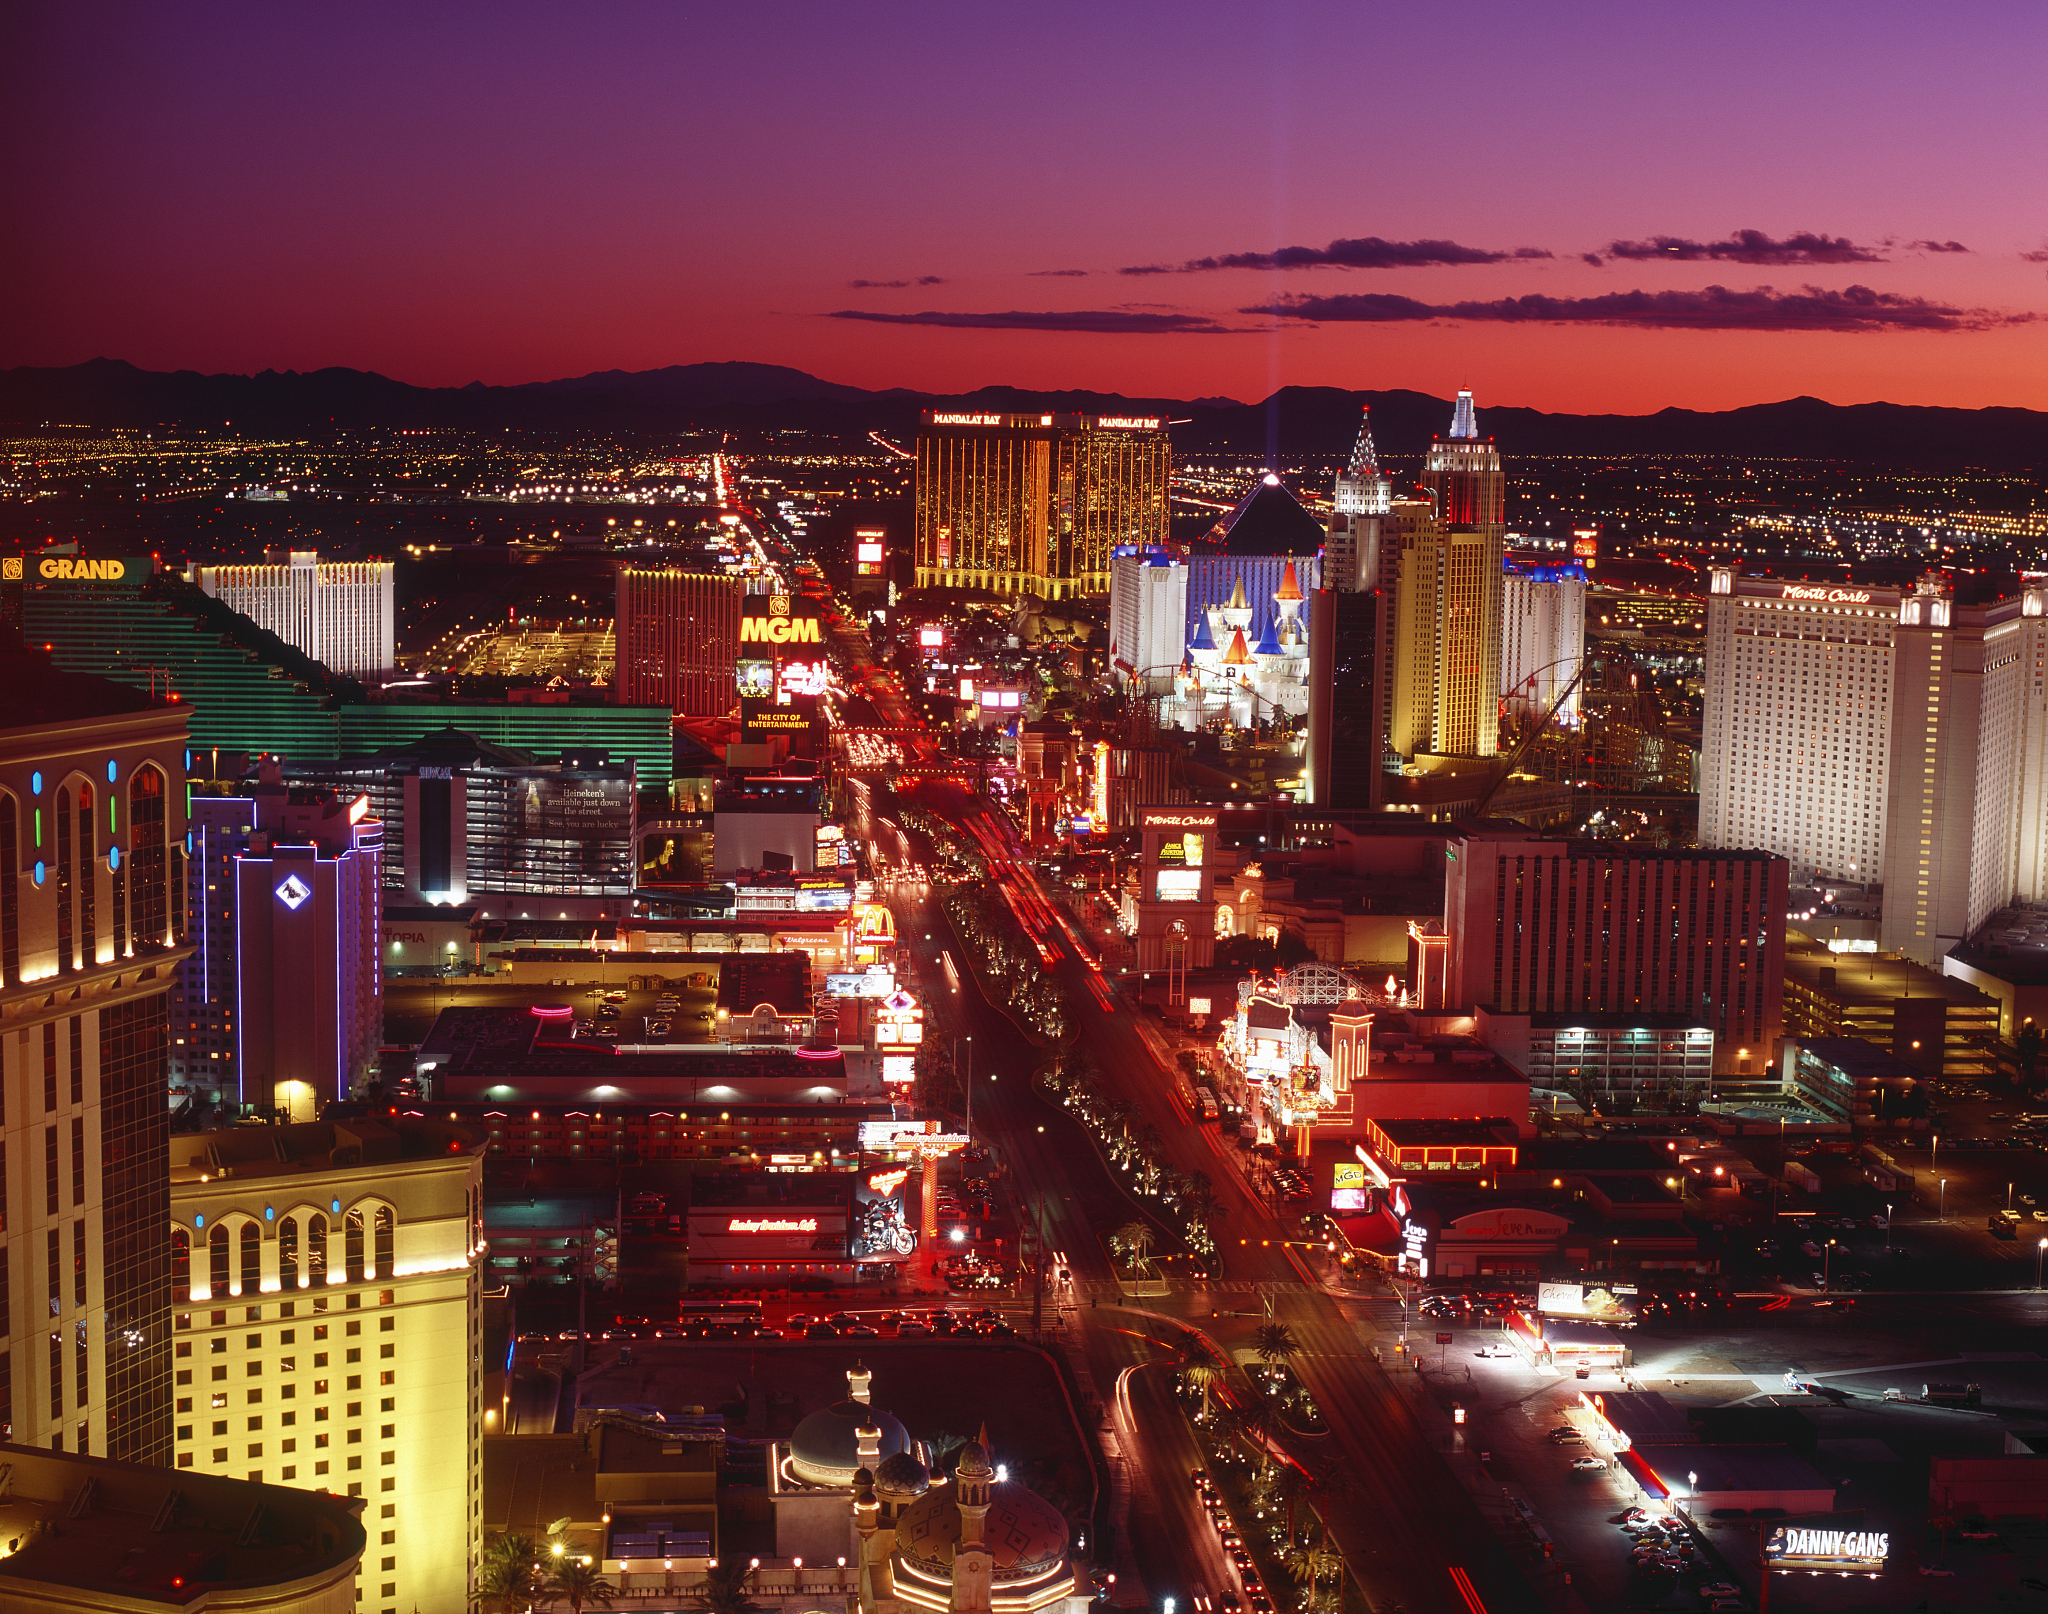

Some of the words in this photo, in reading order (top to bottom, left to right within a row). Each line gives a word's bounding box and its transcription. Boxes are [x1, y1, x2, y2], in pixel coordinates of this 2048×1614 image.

[934, 415, 982, 424] MANDALAY
[984, 415, 1001, 425] BAY
[1099, 418, 1143, 428] MANDALAY
[1144, 419, 1160, 429] BAY
[39, 558, 125, 580] GRAND
[1782, 585, 1827, 600] Monte
[1828, 589, 1870, 604] Carlo
[740, 617, 820, 643] MGM
[740, 686, 770, 695] EFX
[748, 720, 810, 729] ENTERTAINMENT
[563, 789, 605, 798] Heineken's
[547, 798, 582, 806] available
[582, 798, 599, 807] just
[600, 798, 621, 807] down
[564, 806, 577, 815] the
[566, 821, 580, 830] you
[1144, 816, 1182, 826] Monte
[1181, 816, 1216, 826] Carlo
[783, 937, 830, 945] Walgreens
[894, 1132, 971, 1143] Harley-Davidson
[1335, 1171, 1362, 1184] MGD
[1402, 1218, 1428, 1238] Seven
[1490, 1212, 1534, 1240] Seven
[1542, 1286, 1579, 1300] Cheval
[1785, 1529, 1845, 1556] DANNY
[1844, 1531, 1889, 1558] GANS
